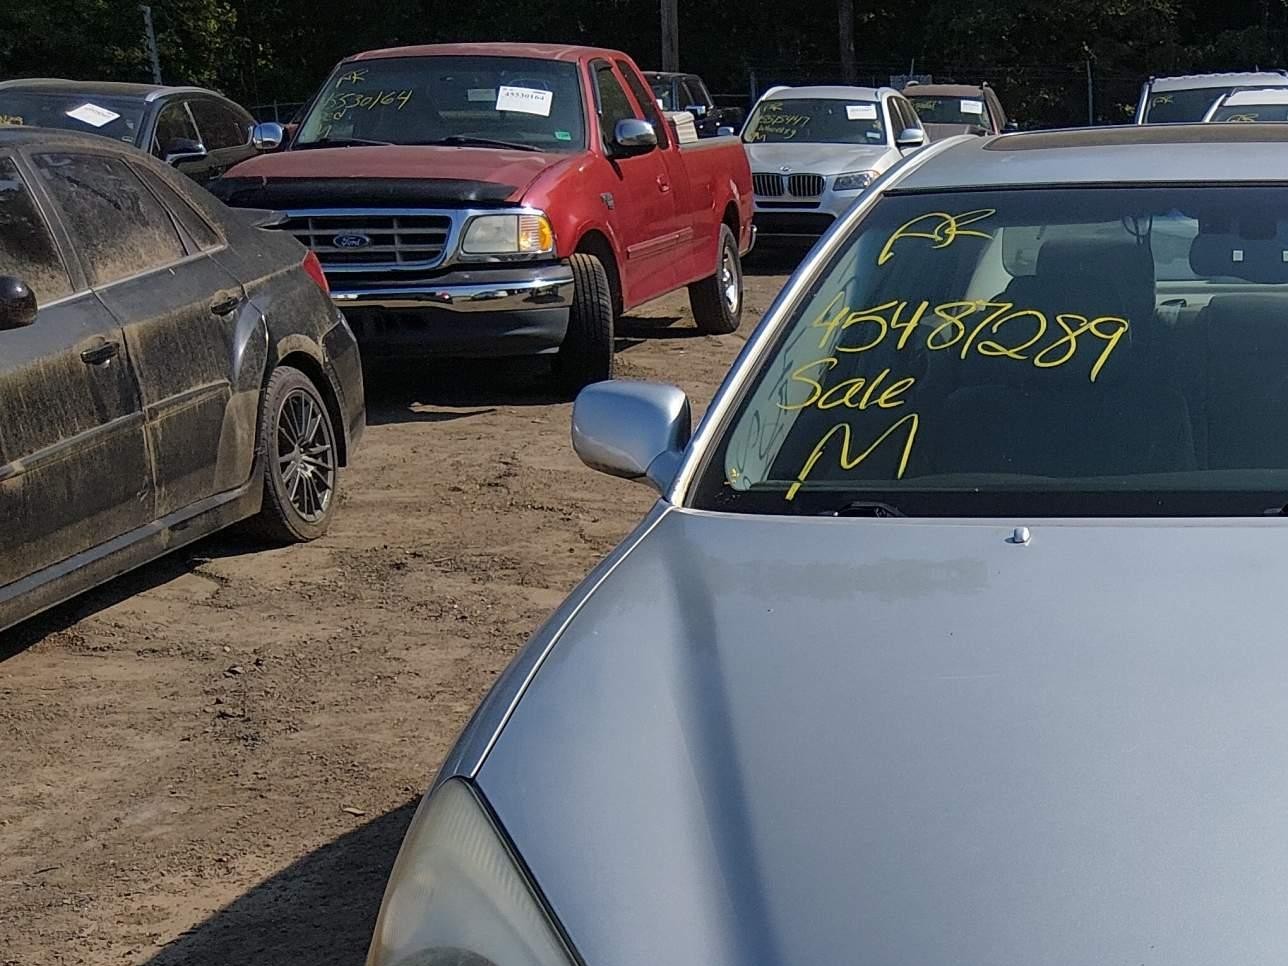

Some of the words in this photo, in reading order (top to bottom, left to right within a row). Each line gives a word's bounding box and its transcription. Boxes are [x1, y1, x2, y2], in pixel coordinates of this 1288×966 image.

[813, 291, 1129, 383] 45487289
[776, 357, 915, 411] Sale
[785, 413, 919, 501] M
